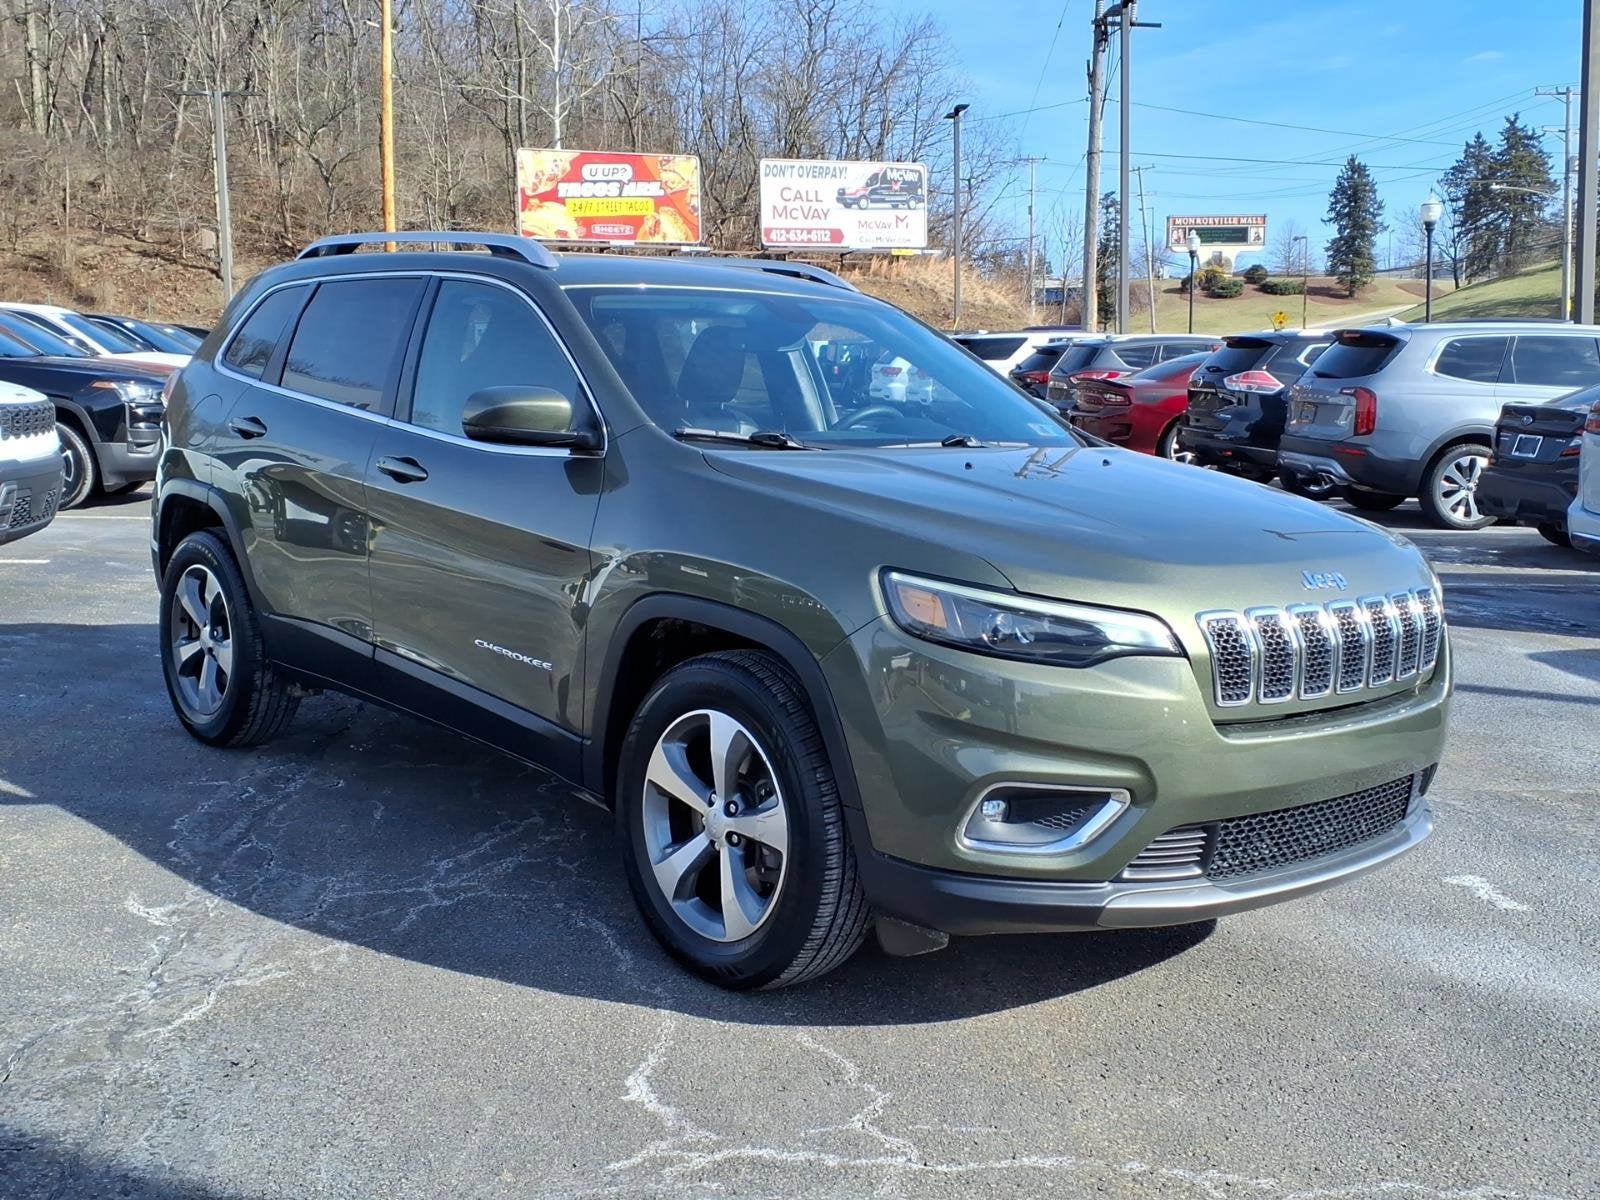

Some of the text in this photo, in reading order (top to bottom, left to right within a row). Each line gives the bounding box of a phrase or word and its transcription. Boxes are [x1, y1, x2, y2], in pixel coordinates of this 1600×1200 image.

[589, 167, 628, 177] U UP?
[764, 164, 848, 179] DON'T OVERPAY!
[780, 187, 823, 202] CALL
[572, 200, 650, 213] 24/7 STREET TACOS
[1175, 216, 1264, 225] MONROEVILLE MALL
[1301, 570, 1348, 591] Jeep
[474, 639, 553, 671] CHEROKEE
